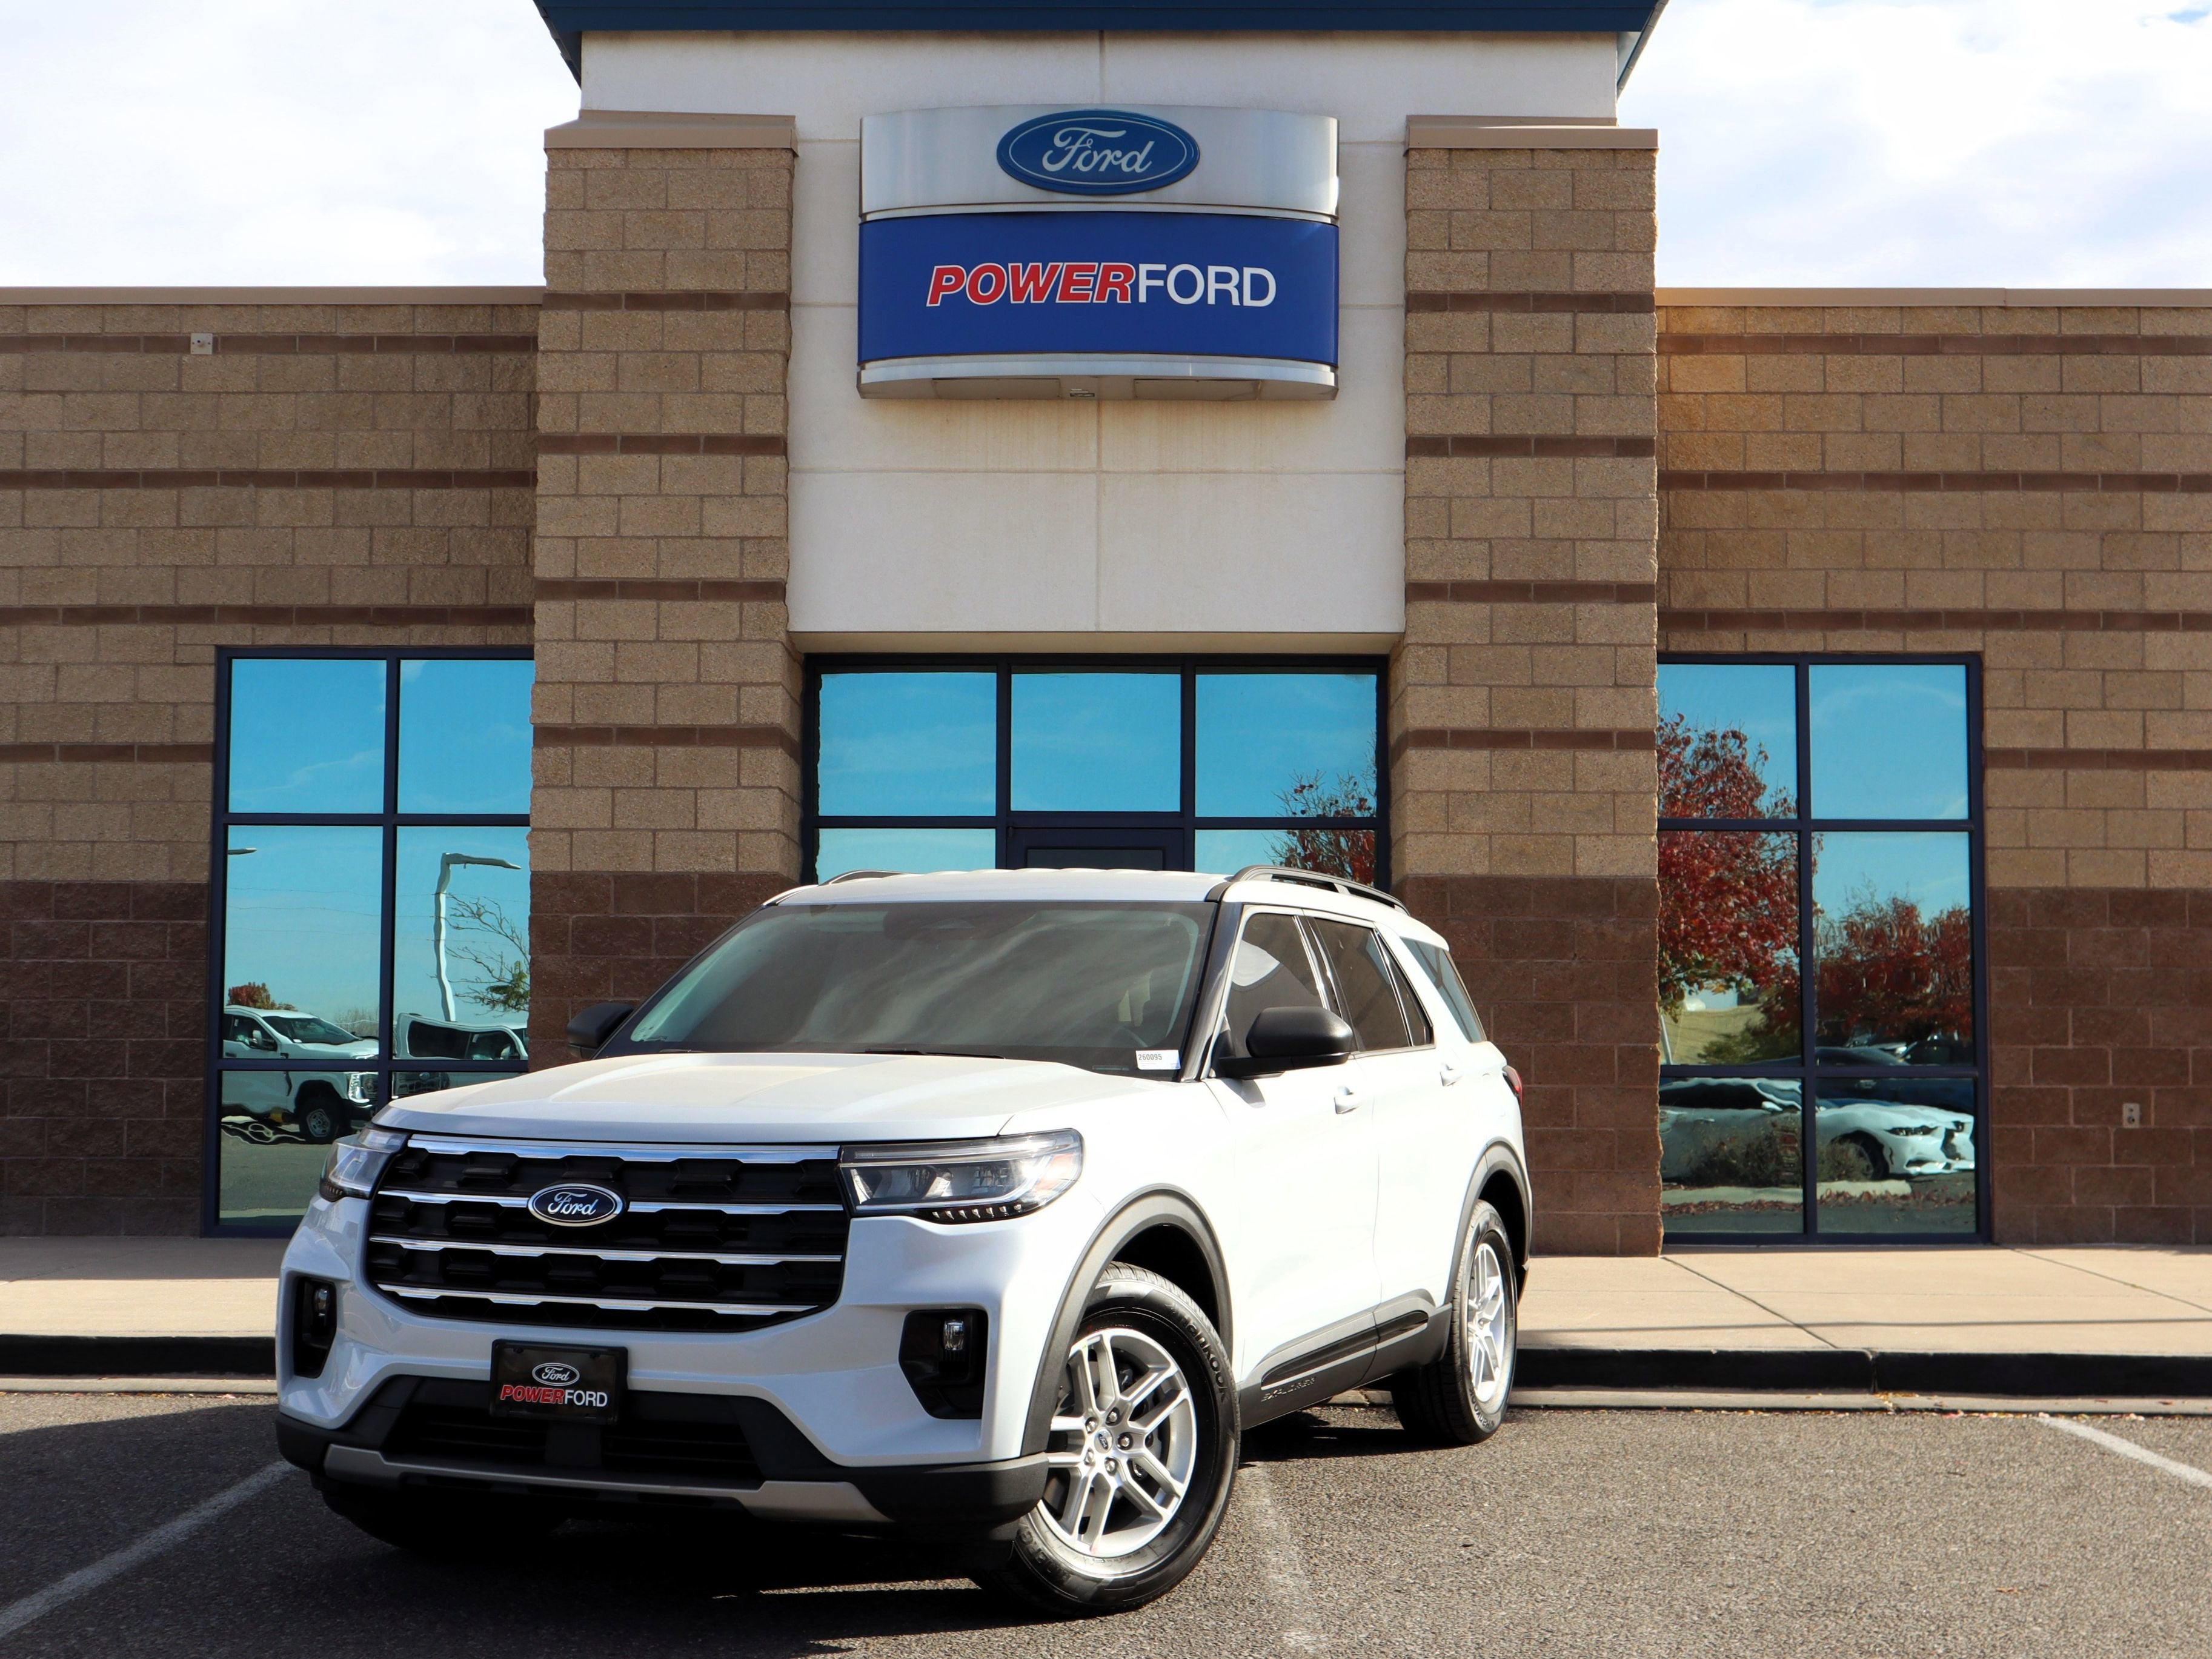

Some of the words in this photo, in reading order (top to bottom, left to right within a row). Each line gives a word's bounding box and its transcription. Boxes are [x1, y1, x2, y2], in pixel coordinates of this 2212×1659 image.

[1042, 127, 1154, 173] Ford
[926, 262, 1277, 307] POWERFORD
[548, 1191, 599, 1216] Ford
[542, 1366, 570, 1381] Ford
[500, 1385, 608, 1407] POWERFORD
